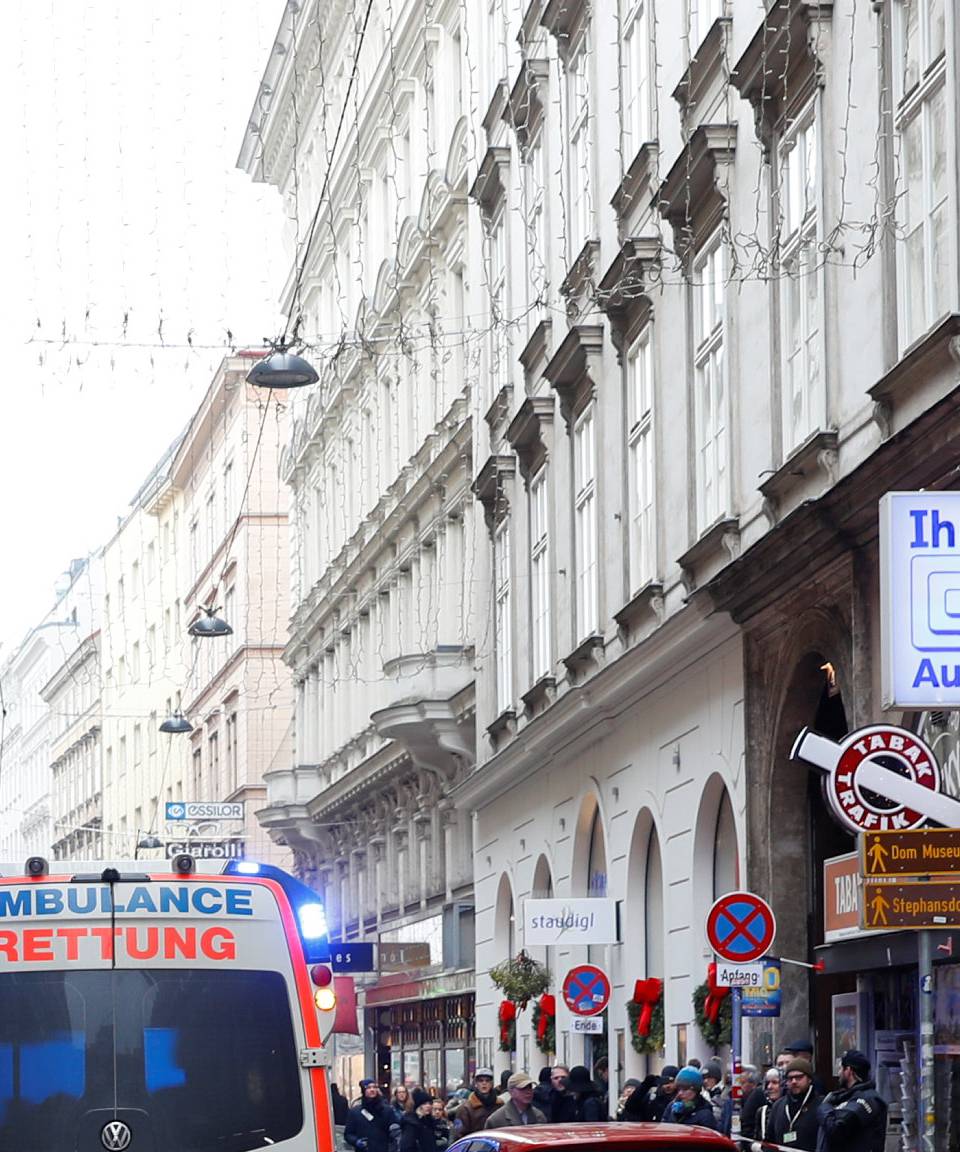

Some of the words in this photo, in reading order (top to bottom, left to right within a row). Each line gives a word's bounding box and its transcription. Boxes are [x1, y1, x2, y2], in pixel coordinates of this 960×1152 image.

[853, 734, 933, 779] TABAK
[838, 772, 911, 830] TRAFIK
[892, 844, 917, 859] Dom
[835, 872, 864, 915] TABA
[532, 912, 594, 931] staudigl
[0, 927, 236, 962] RETTUNG
[574, 1020, 597, 1030] Ende
